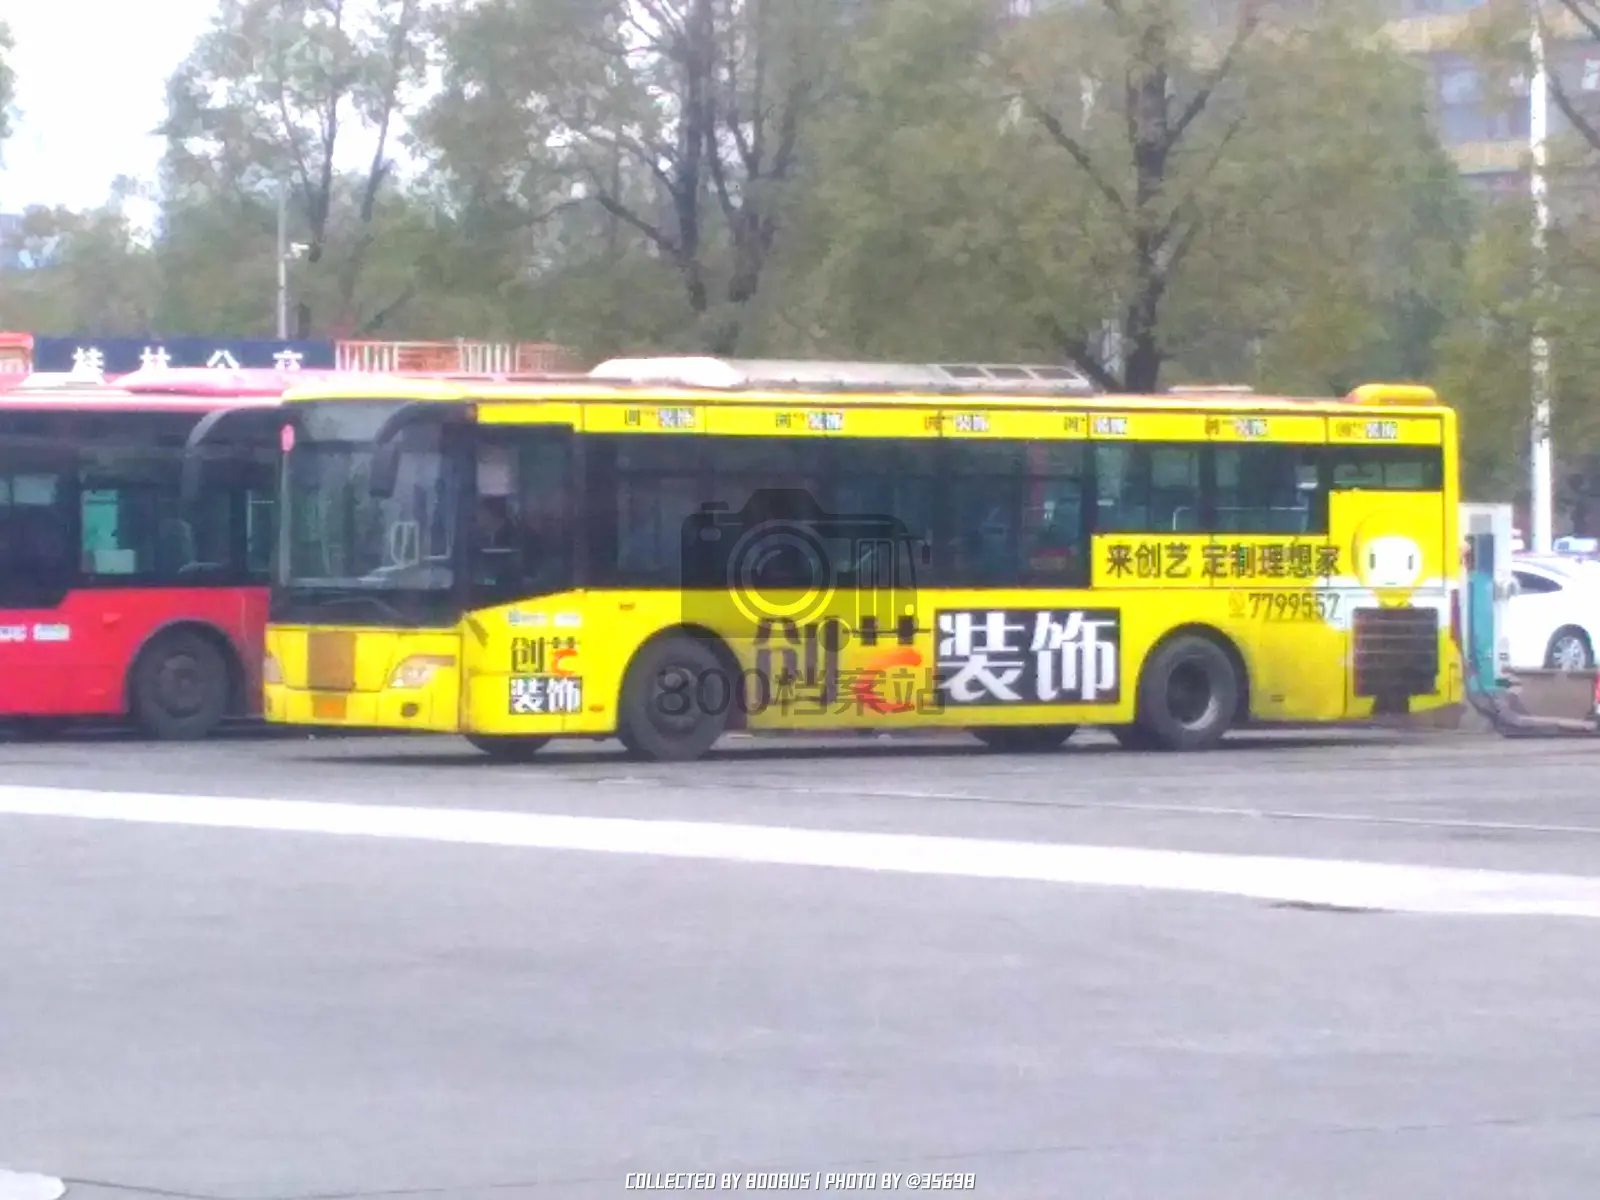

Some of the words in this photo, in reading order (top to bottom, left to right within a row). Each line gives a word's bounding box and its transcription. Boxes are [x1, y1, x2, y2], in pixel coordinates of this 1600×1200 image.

[1106, 543, 1192, 579] 来创艺
[1201, 544, 1341, 578] 定制理想家
[510, 678, 582, 713] 装饰
